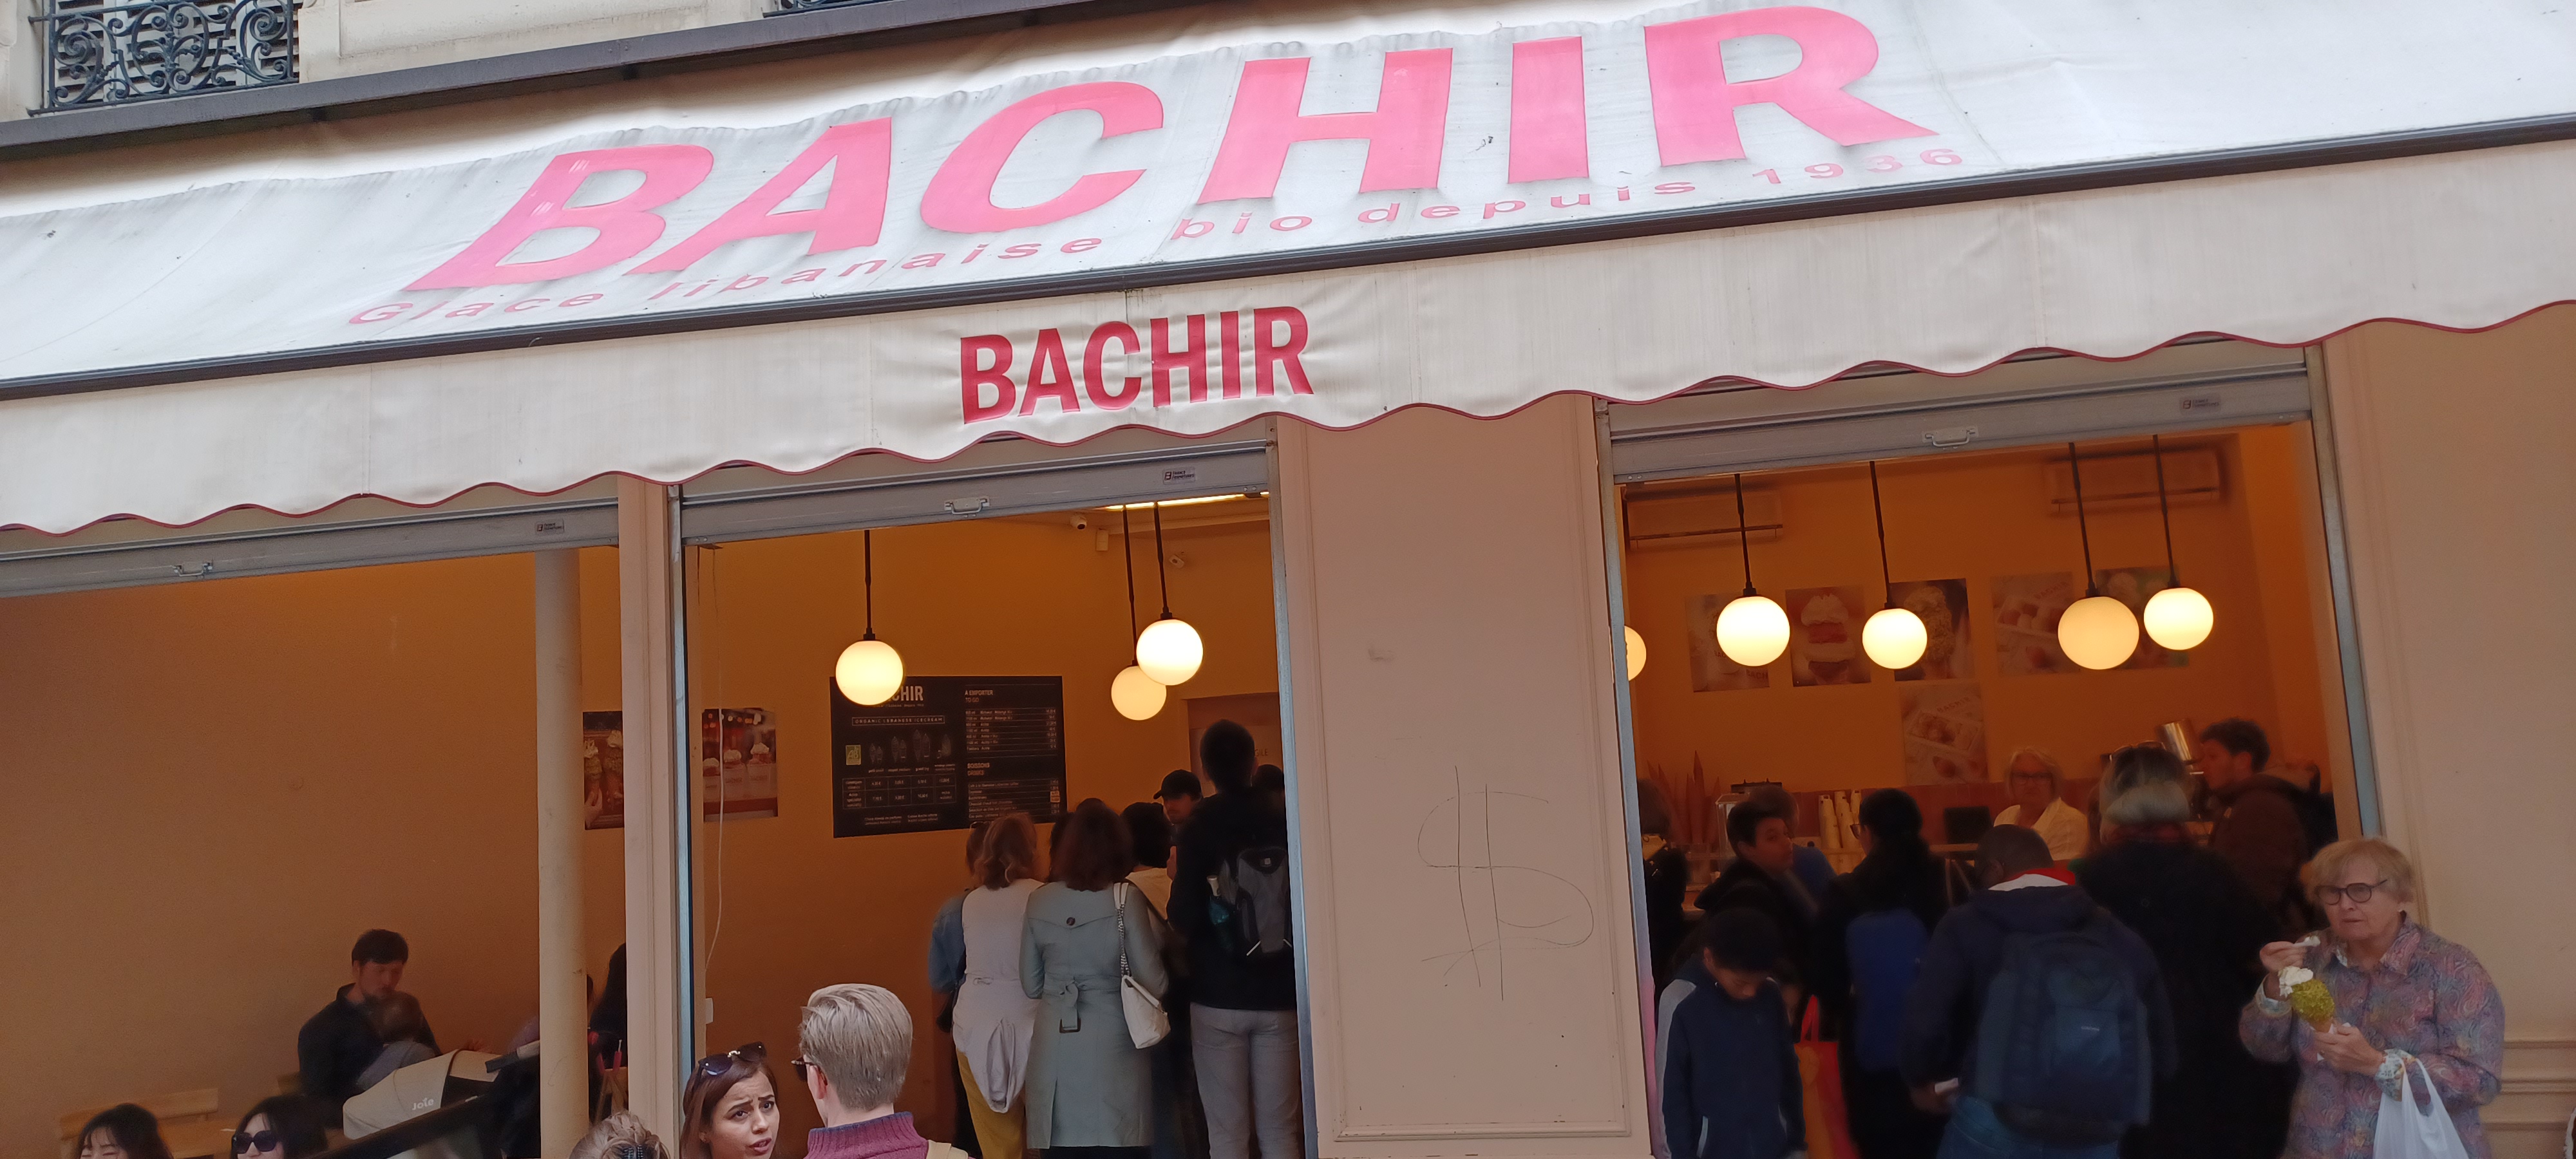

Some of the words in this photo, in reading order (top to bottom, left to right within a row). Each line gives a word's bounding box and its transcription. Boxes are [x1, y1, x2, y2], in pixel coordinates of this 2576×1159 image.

[402, 5, 1938, 291] BACHIR
[348, 294, 604, 325] Glace
[648, 238, 1102, 301] libanaise
[1170, 212, 1312, 240] bio
[1357, 181, 1696, 223] depuis
[1752, 148, 1963, 184] 1936
[960, 306, 1314, 424] BACHIR
[412, 1097, 434, 1111] Joie
